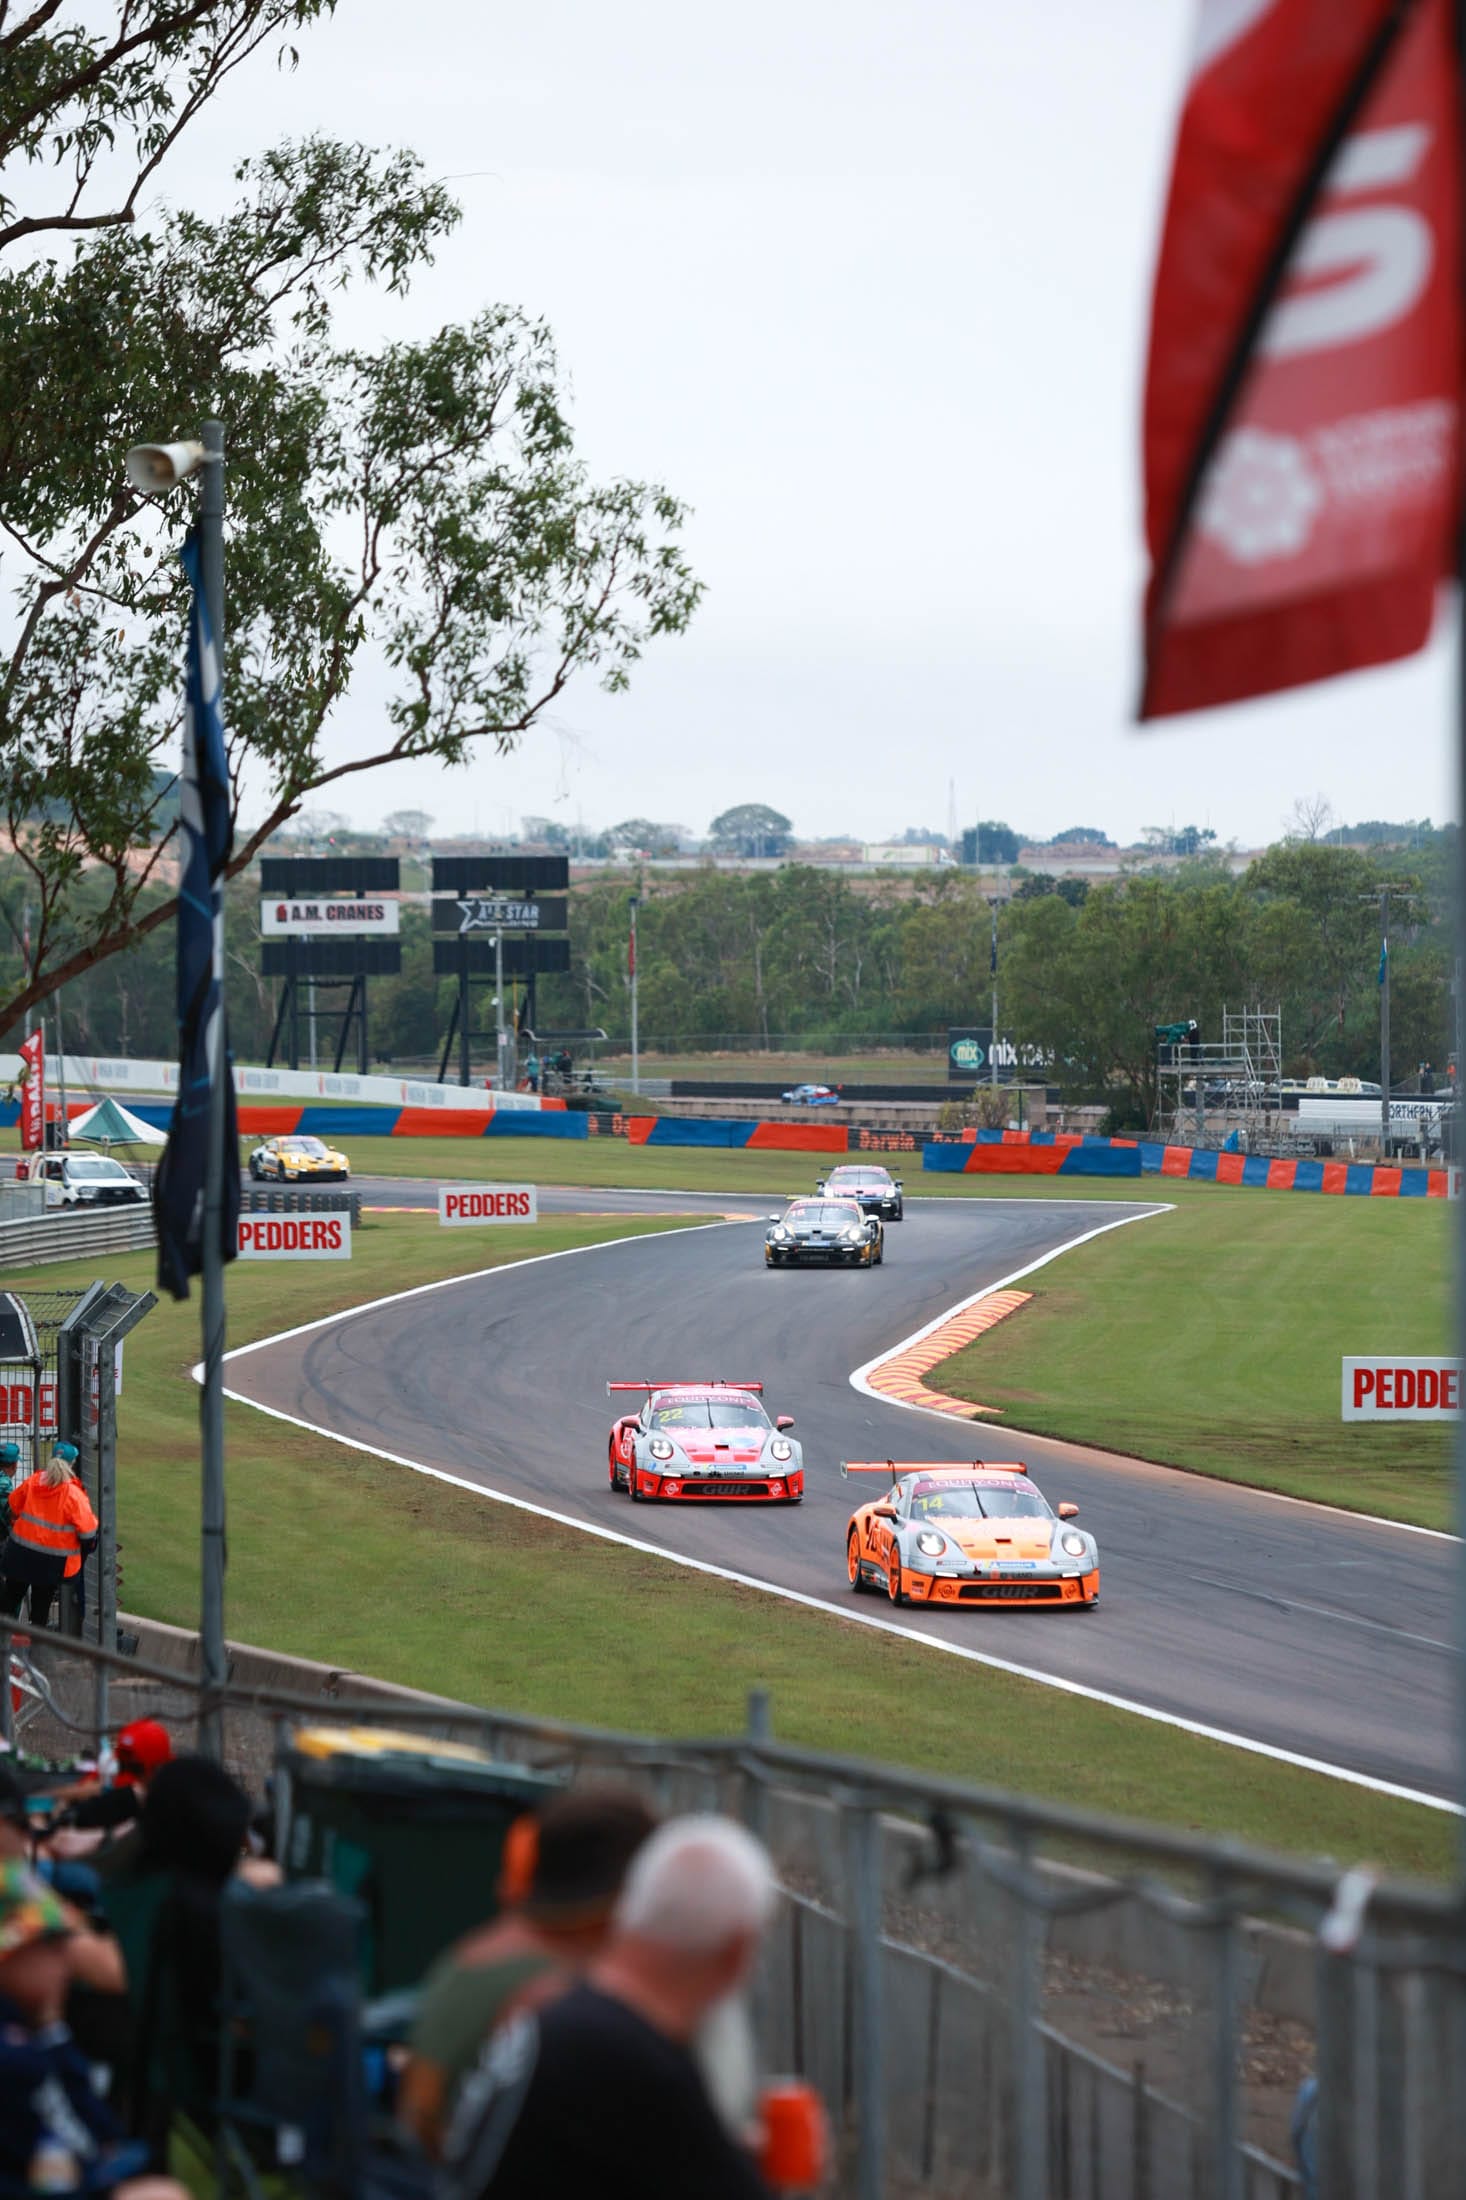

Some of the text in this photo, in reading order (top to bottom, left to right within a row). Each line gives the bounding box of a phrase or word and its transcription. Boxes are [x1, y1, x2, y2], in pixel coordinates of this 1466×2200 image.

[292, 905, 385, 921] A.M. CRANES
[506, 905, 539, 919] STAR
[988, 1037, 1018, 1066] mix
[1389, 1103, 1433, 1120] ORTHERN
[445, 1192, 530, 1218] PEDDERS
[238, 1219, 342, 1251] PEDDERS
[658, 1407, 684, 1423] 22
[701, 1484, 749, 1495] GWR
[918, 1496, 945, 1512] 14
[981, 1585, 1039, 1598] GWR
